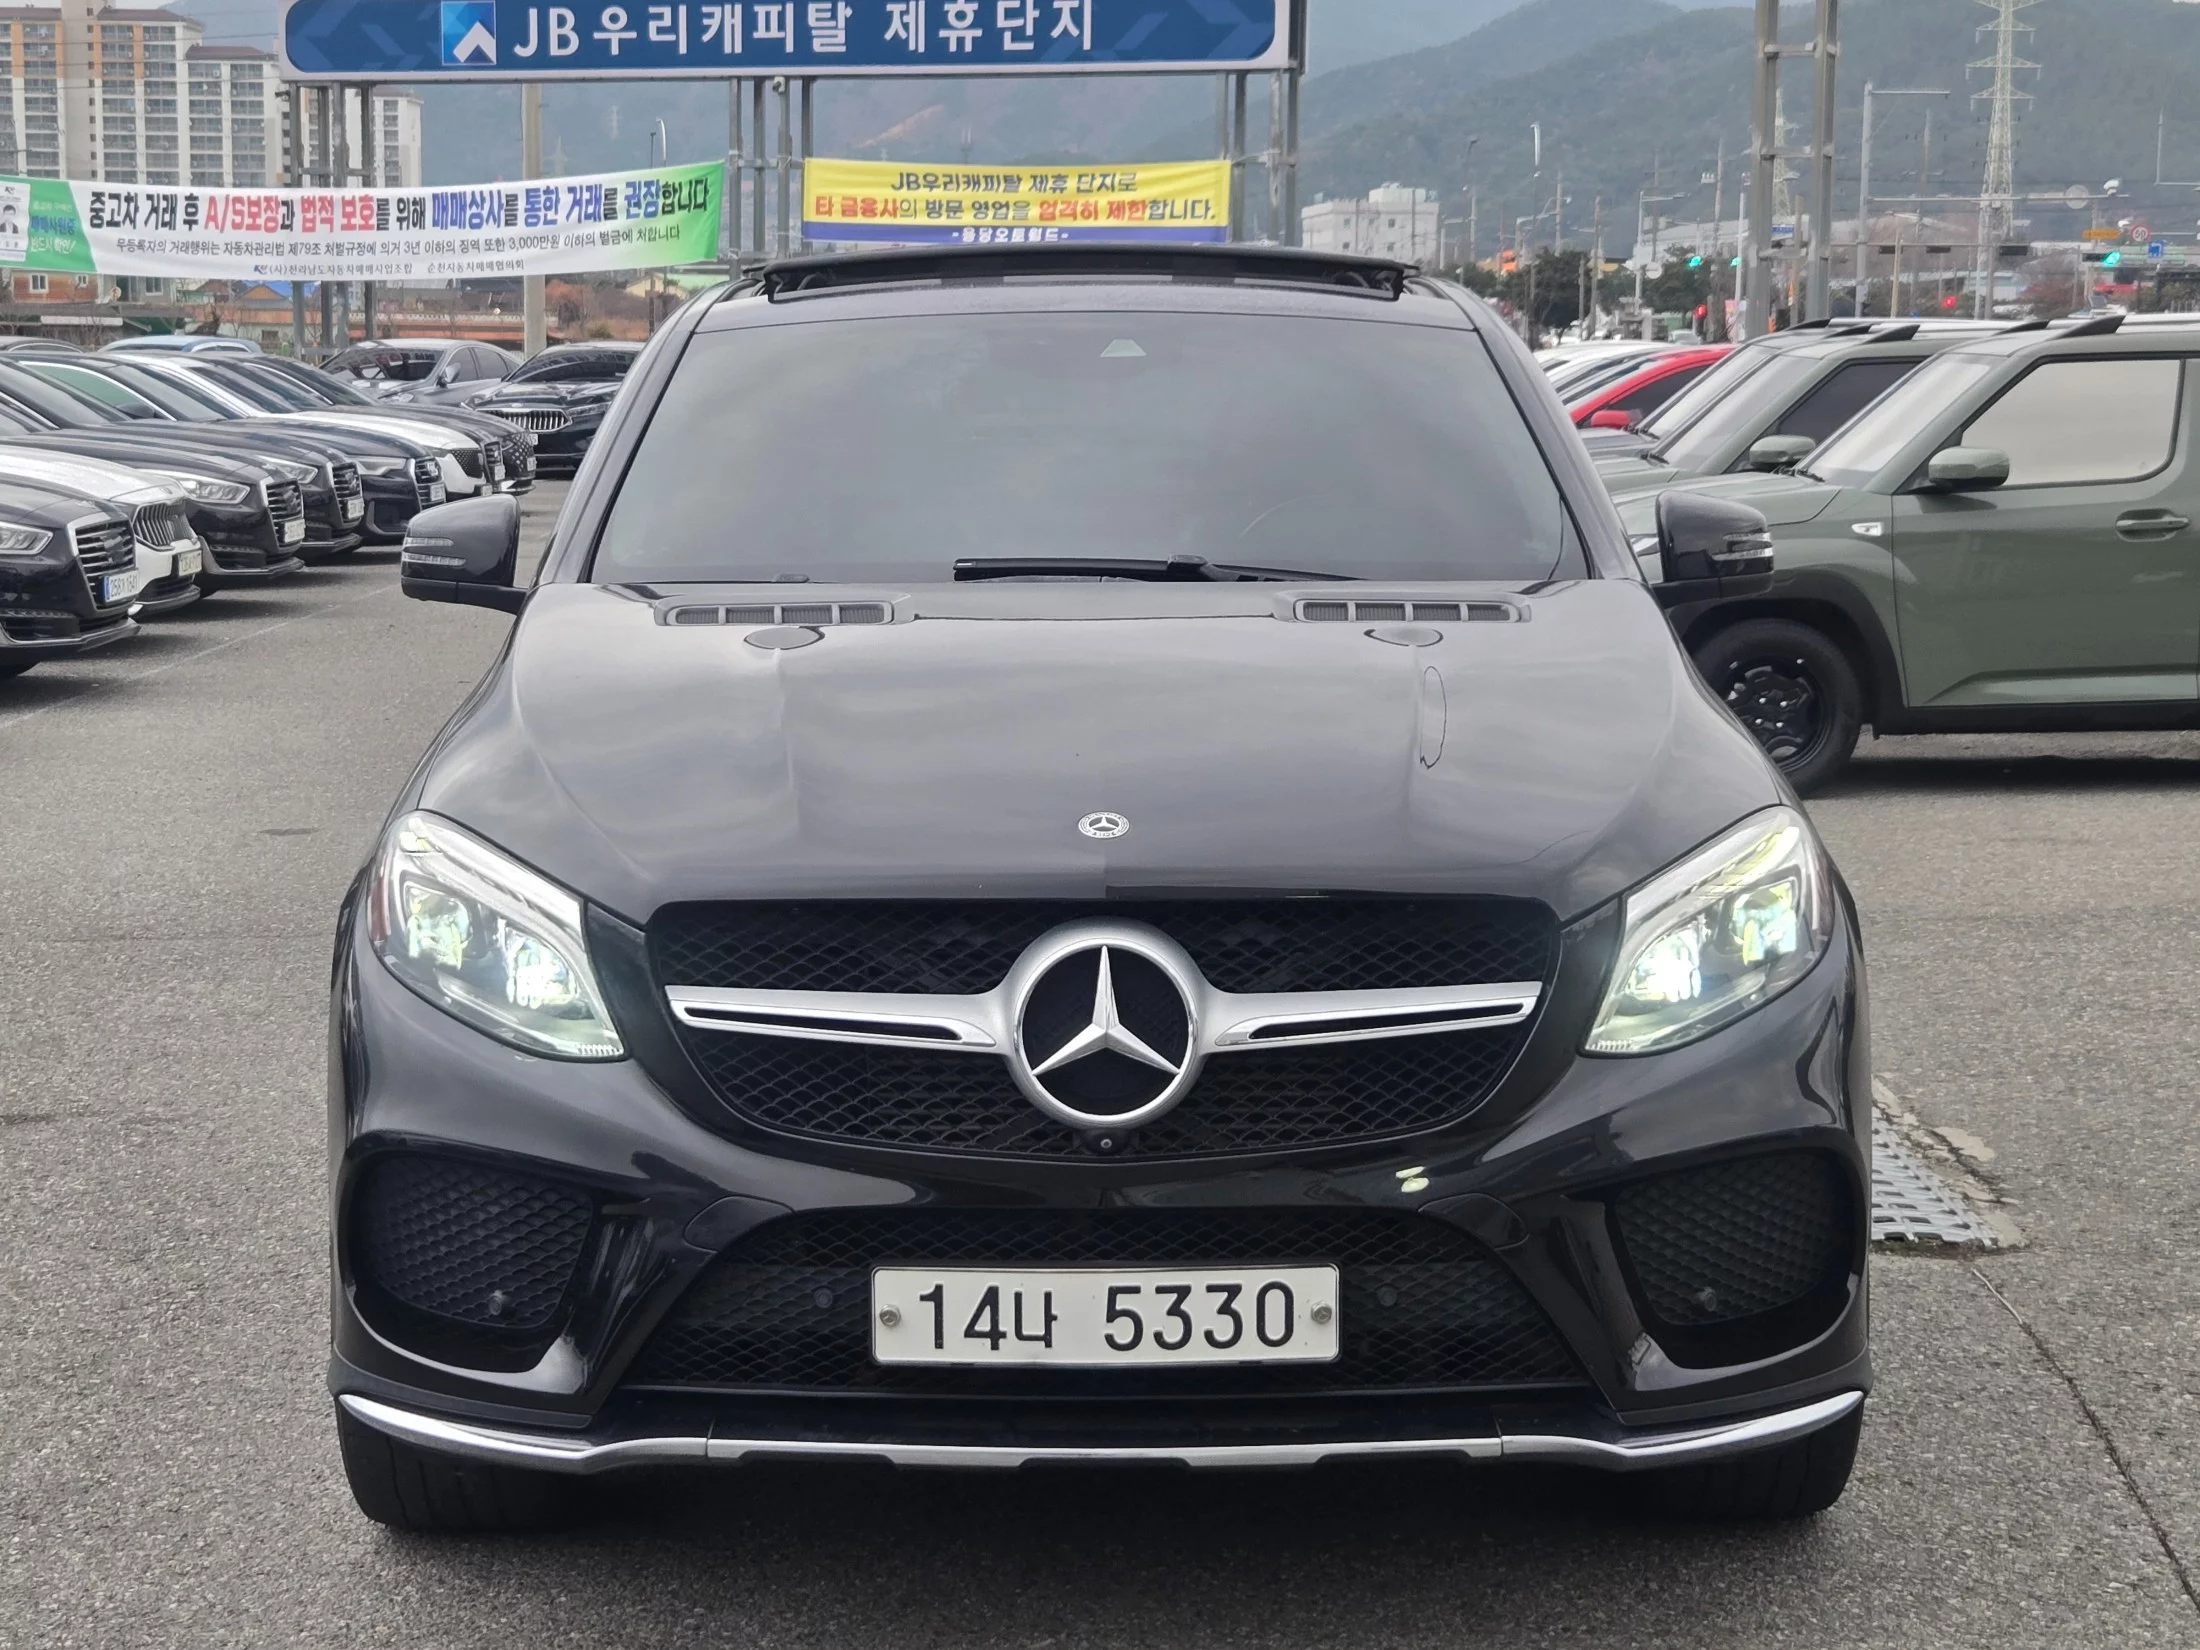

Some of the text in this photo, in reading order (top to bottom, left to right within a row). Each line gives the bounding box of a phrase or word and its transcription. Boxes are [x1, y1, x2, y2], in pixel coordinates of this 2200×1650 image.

[514, 0, 1092, 57] JB우리캐피탈 제휴단지
[90, 177, 709, 233] 중고차 거래 후 A/S보장과 법적 보호를 위해 매매상사를 통한 거래를 권장합니다
[891, 172, 1138, 194] JB우리캐피탈 제휴 단지로
[815, 196, 1216, 222] 타 금융사의 방문 영업을 엄격히 제한합니다.
[116, 224, 680, 257] 무등록자의 거래행위는 자동차관리법 제79조 처벌규정에 의거 3년 이하의 징역 또한 3,000만원 이하의 벌금에 처합니다
[919, 1280, 1295, 1352] 14나 5330
